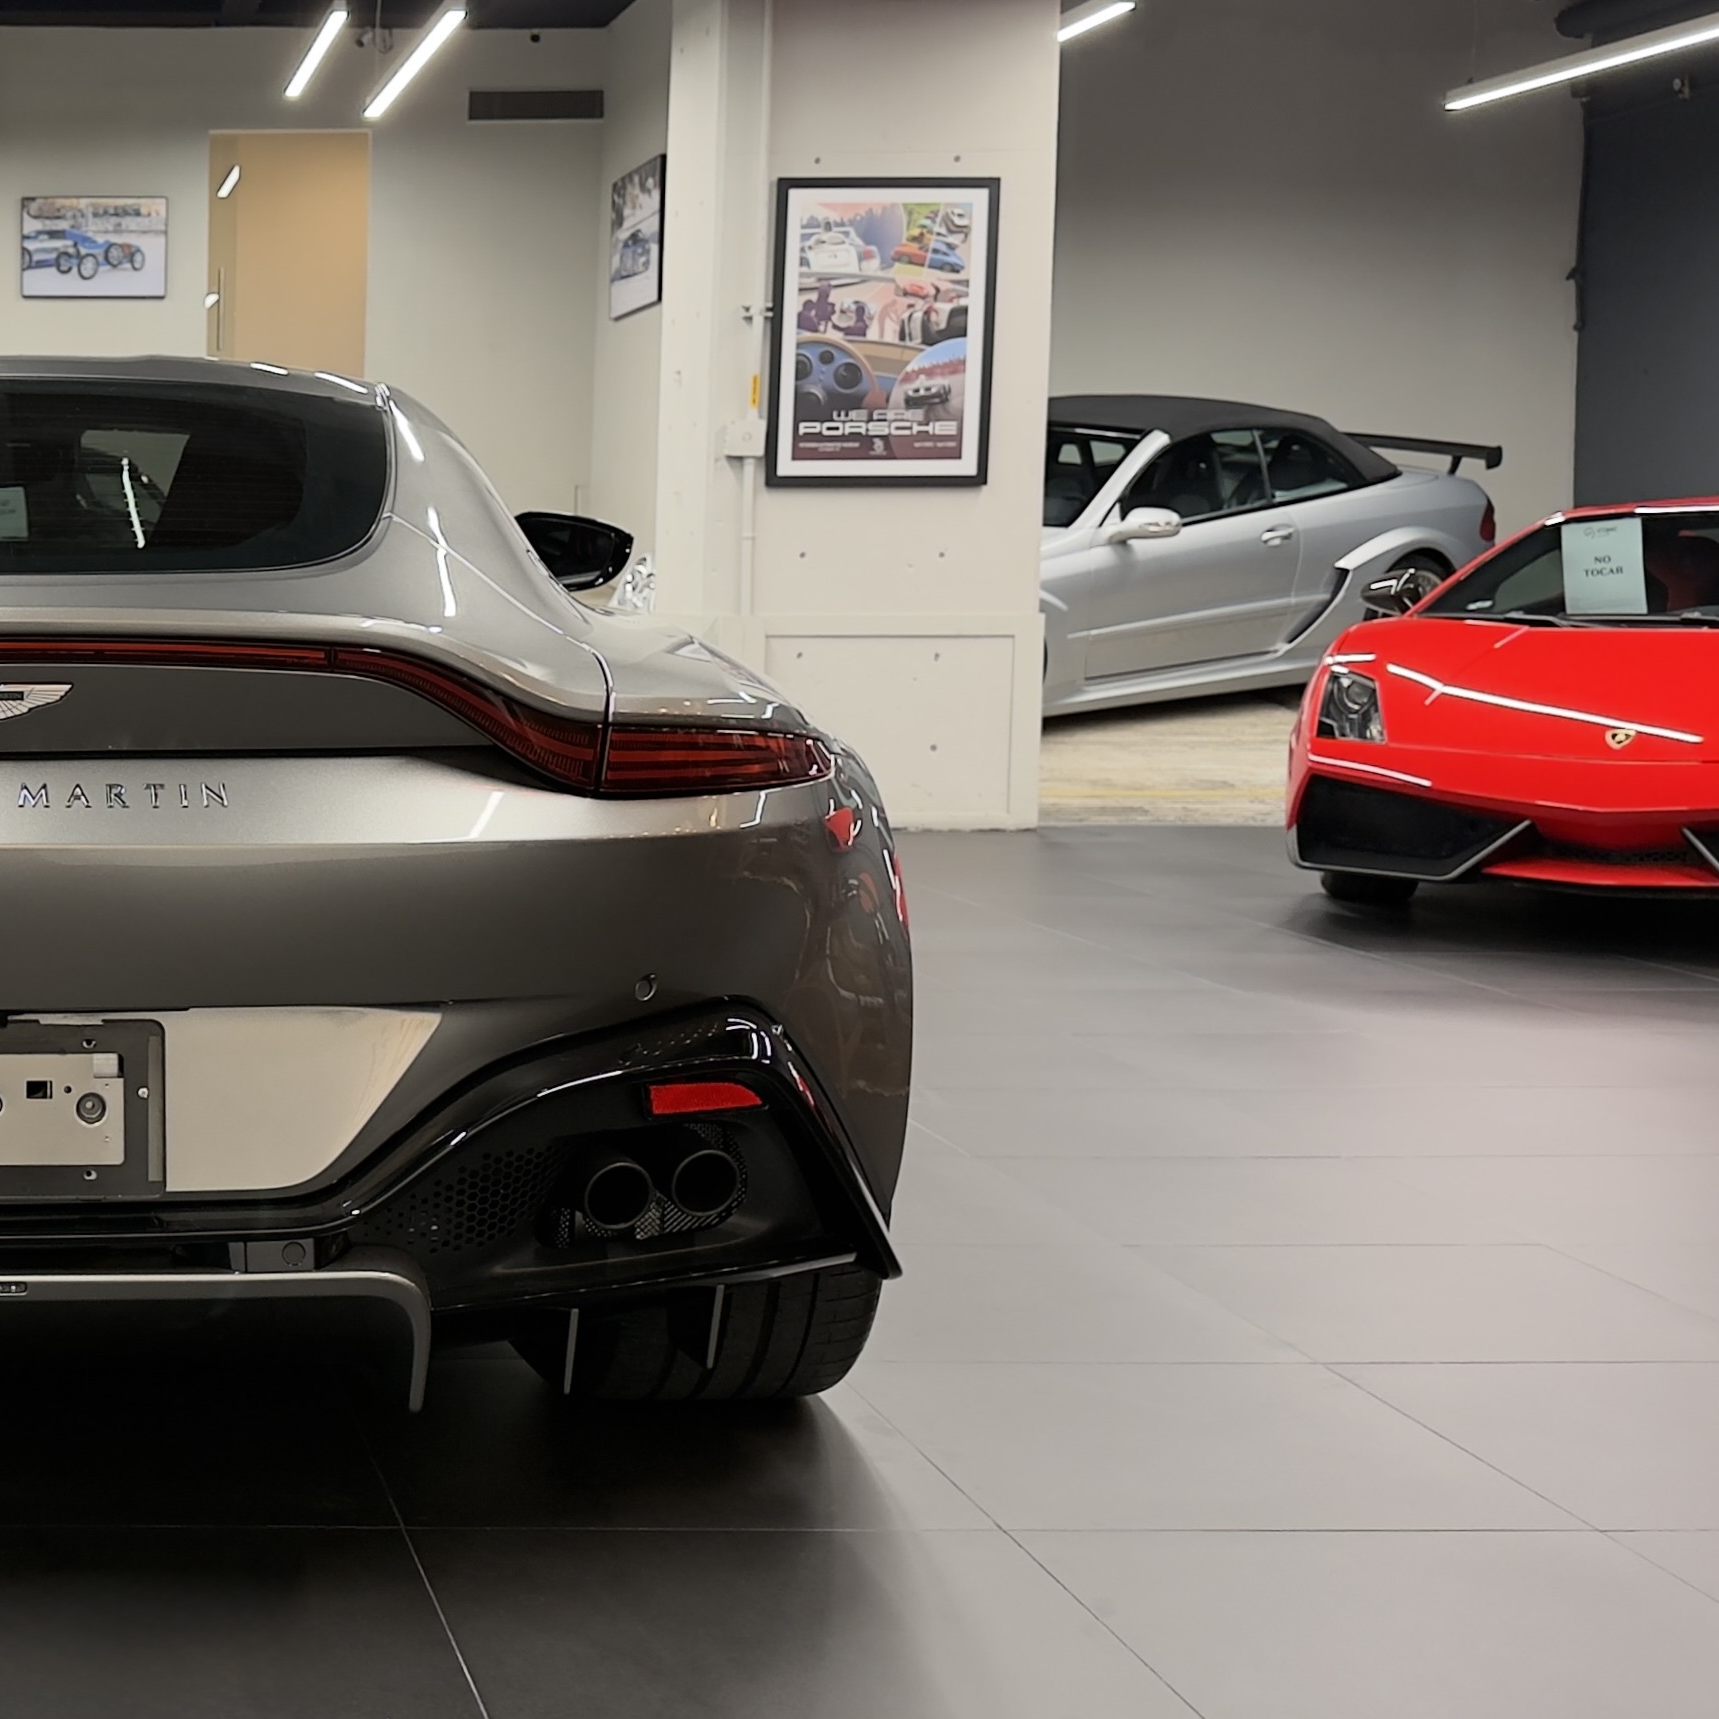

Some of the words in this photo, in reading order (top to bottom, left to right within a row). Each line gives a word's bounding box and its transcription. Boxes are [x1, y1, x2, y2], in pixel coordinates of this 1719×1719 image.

[832, 409, 868, 421] WE
[872, 409, 924, 421] ARE
[798, 421, 958, 436] PORSCHE
[1594, 555, 1611, 564] NO
[1584, 566, 1623, 577] TOCAR
[17, 782, 229, 809] MARTIN
